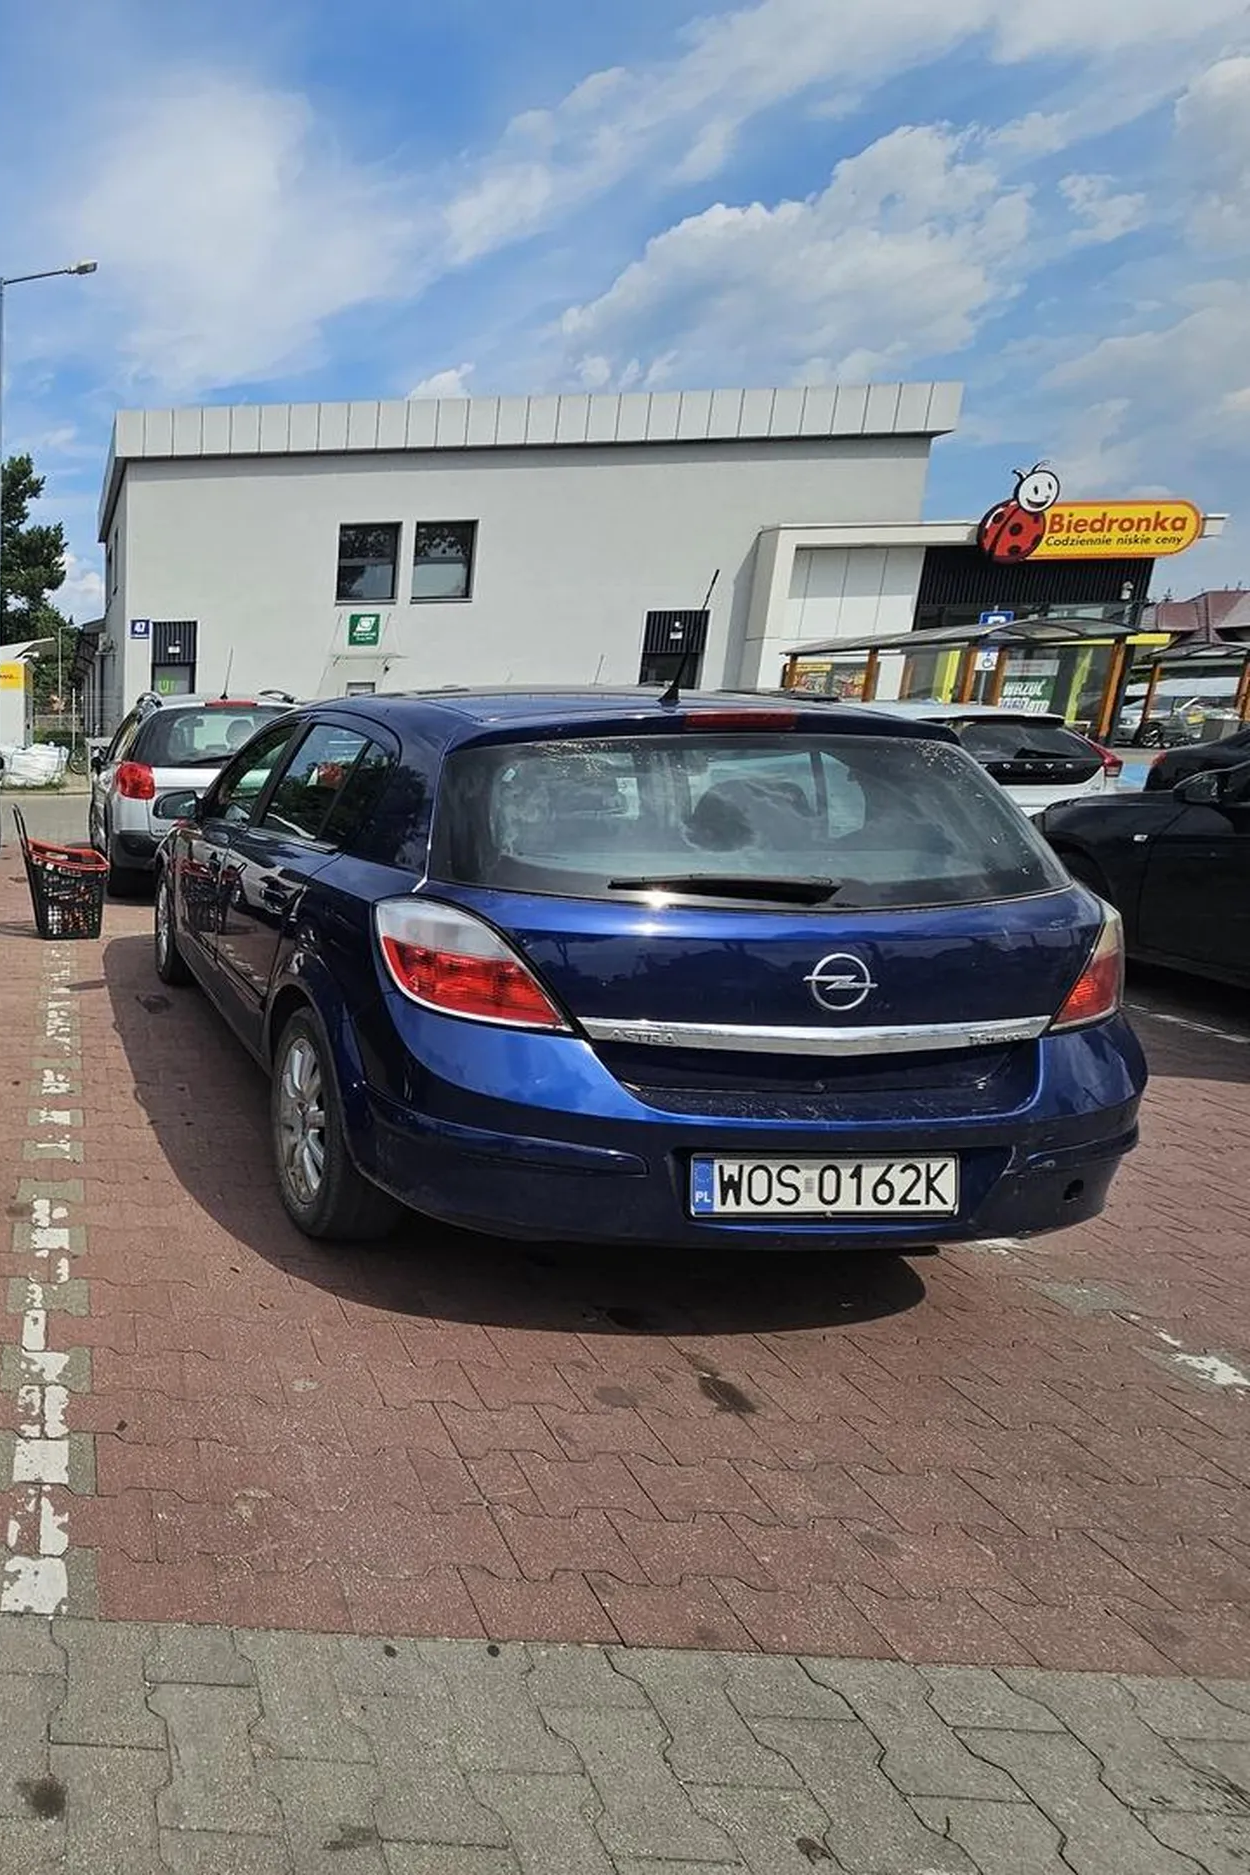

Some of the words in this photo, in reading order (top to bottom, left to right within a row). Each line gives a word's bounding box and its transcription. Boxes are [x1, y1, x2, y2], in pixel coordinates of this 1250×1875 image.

[1047, 511, 1188, 534] Biedronka
[1045, 535, 1112, 547] Codziennie
[1116, 535, 1151, 546] niskie
[1155, 536, 1184, 546] ceny
[718, 1164, 801, 1206] WOS
[817, 1162, 949, 1206] 0162K
[695, 1191, 711, 1203] PL
